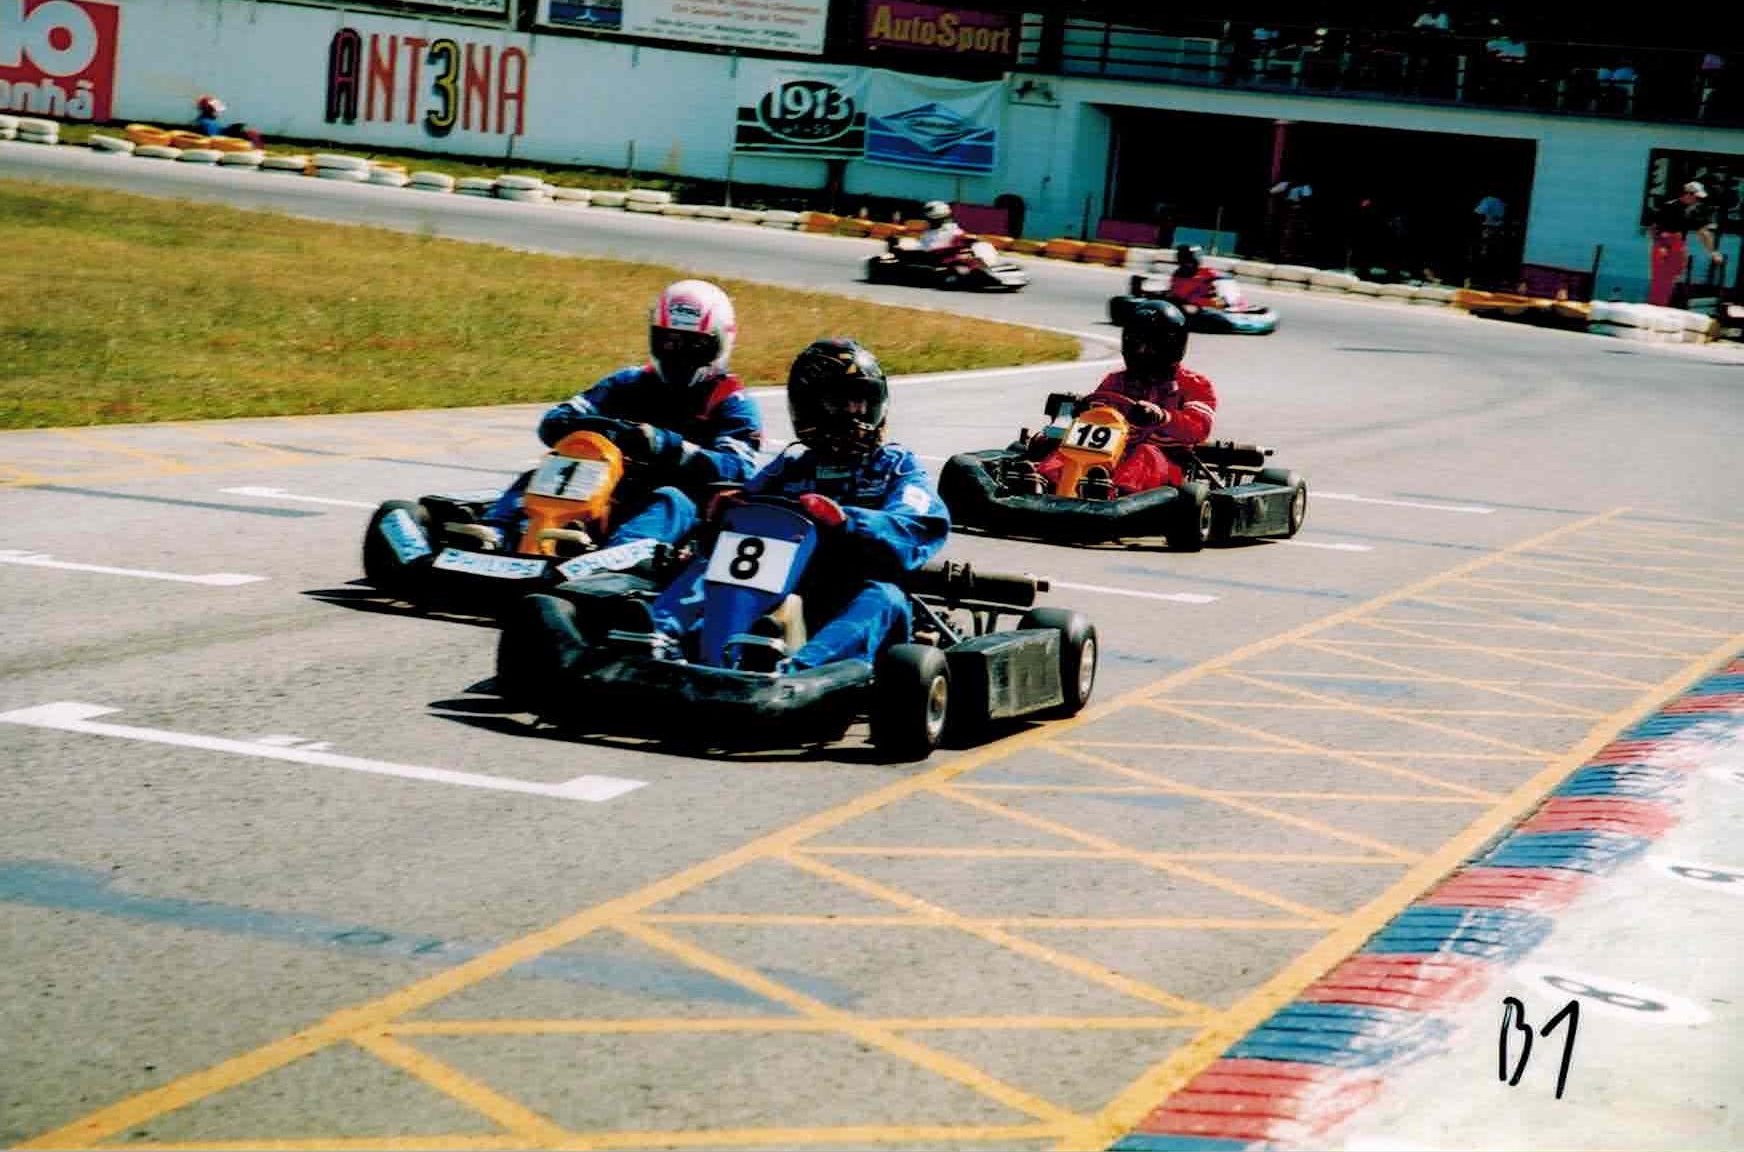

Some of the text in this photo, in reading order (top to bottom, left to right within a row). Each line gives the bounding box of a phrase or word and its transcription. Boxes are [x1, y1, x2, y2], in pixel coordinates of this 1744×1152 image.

[873, 6, 1011, 52] AutoSport
[325, 28, 528, 137] ANT3NA
[770, 84, 850, 120] 1913
[1076, 424, 1111, 448] 19
[555, 459, 580, 496] 1
[729, 537, 765, 581] 8
